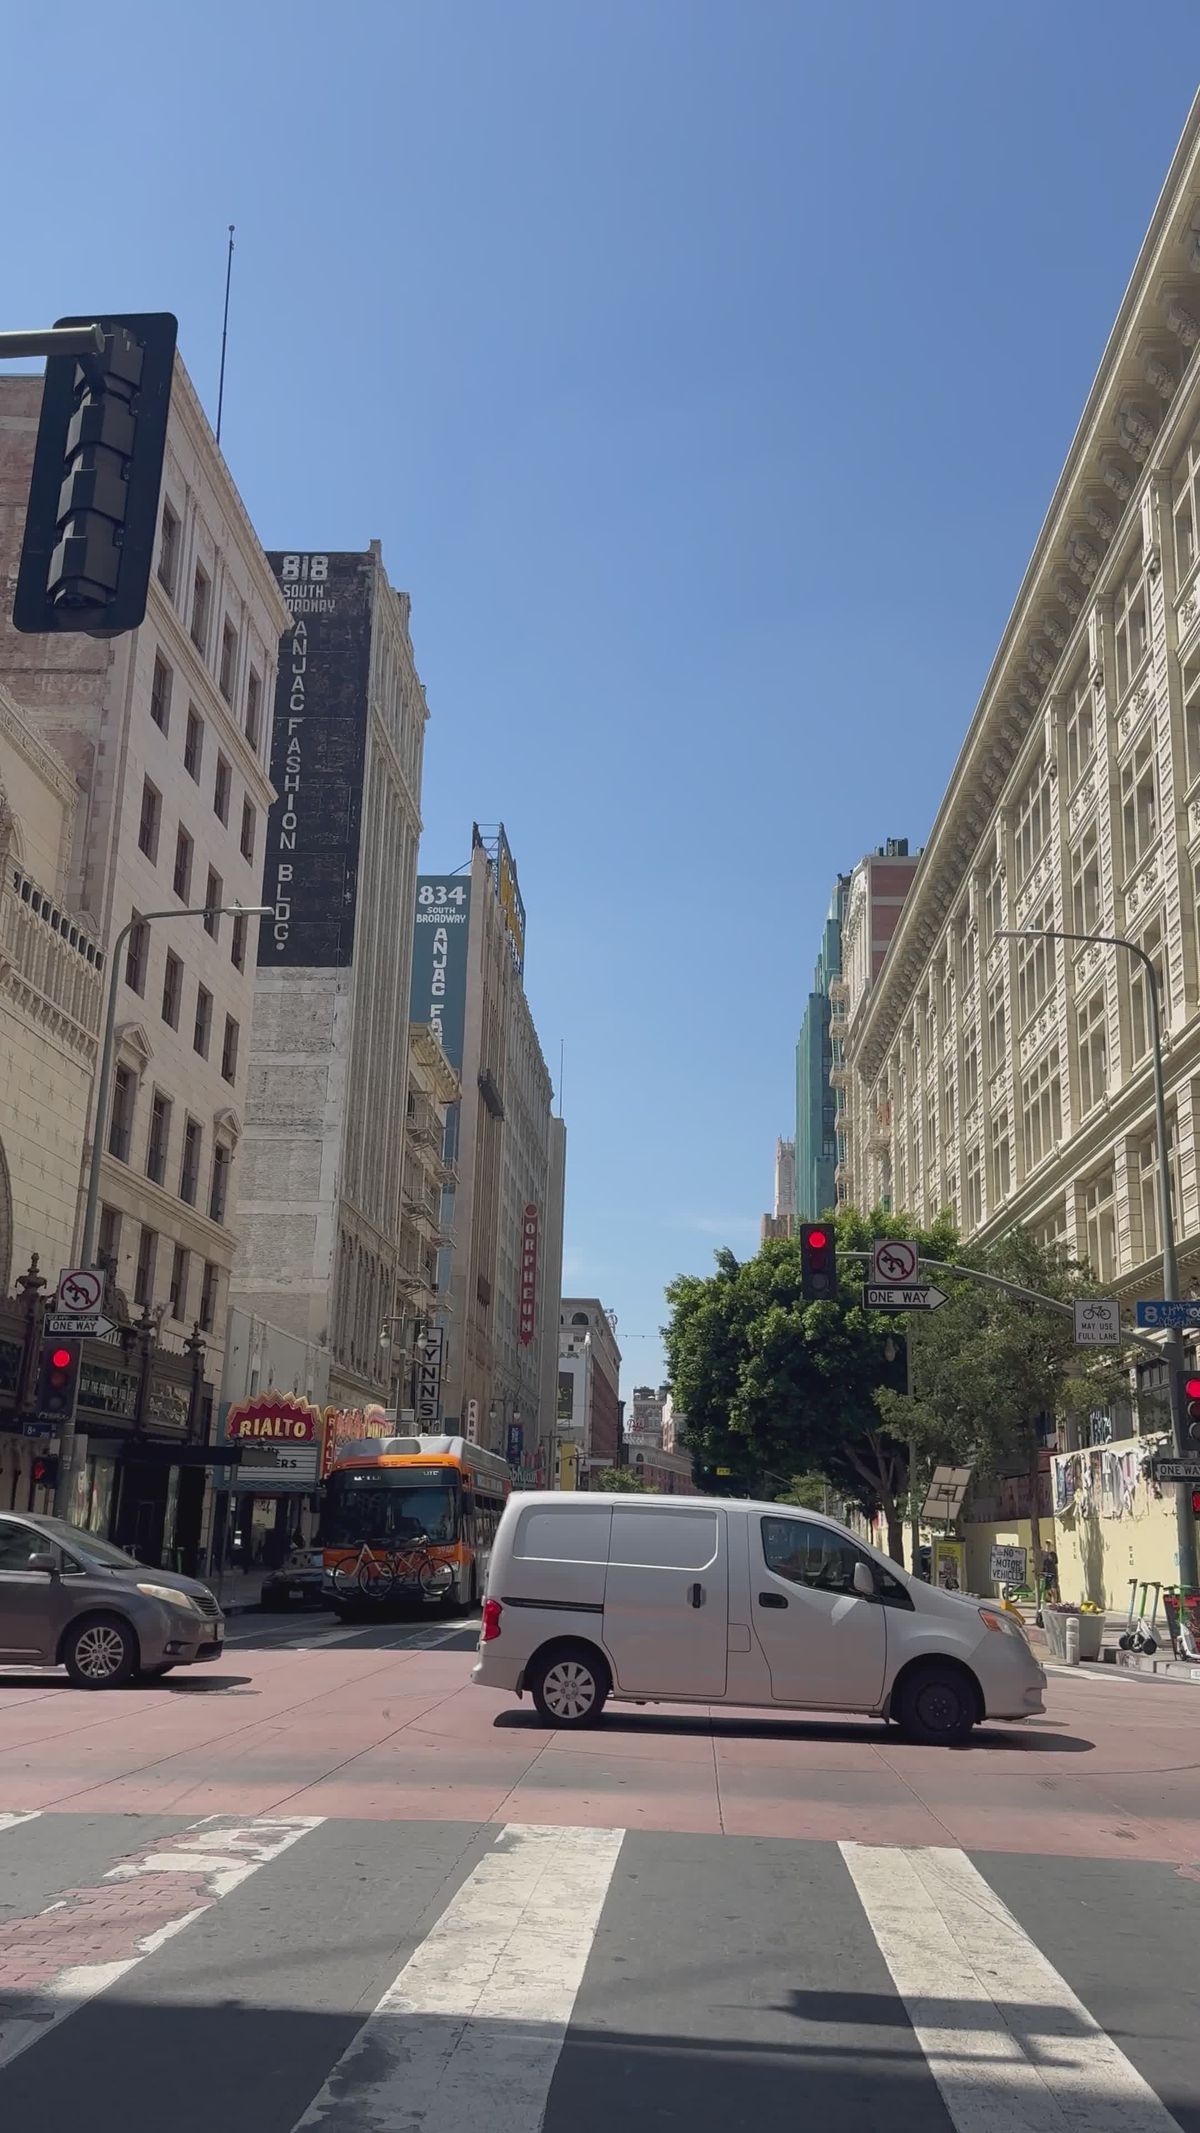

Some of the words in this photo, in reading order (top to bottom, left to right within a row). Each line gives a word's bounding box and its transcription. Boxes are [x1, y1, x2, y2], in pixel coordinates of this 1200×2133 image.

[282, 555, 328, 580] 818
[283, 584, 324, 598] SOUTH
[289, 620, 308, 711] ANJAC
[280, 717, 304, 850] FASHION
[418, 885, 467, 906] 834
[274, 864, 293, 951] BLDG.
[426, 906, 456, 914] SOUTH
[416, 913, 467, 924] BROADWAY
[431, 927, 448, 997] ANJAC
[521, 1222, 536, 1332] ORPHEUM
[869, 1291, 895, 1303] ONE
[902, 1291, 929, 1303] WAY
[52, 1321, 73, 1330] ONE
[76, 1321, 97, 1330] WAY
[1100, 1323, 1113, 1331] USE
[1078, 1332, 1096, 1340] FULL
[1100, 1333, 1118, 1341] LANE
[239, 1417, 307, 1438] RIALTO
[1160, 1465, 1181, 1475] ONE
[1003, 1548, 1014, 1558] NO
